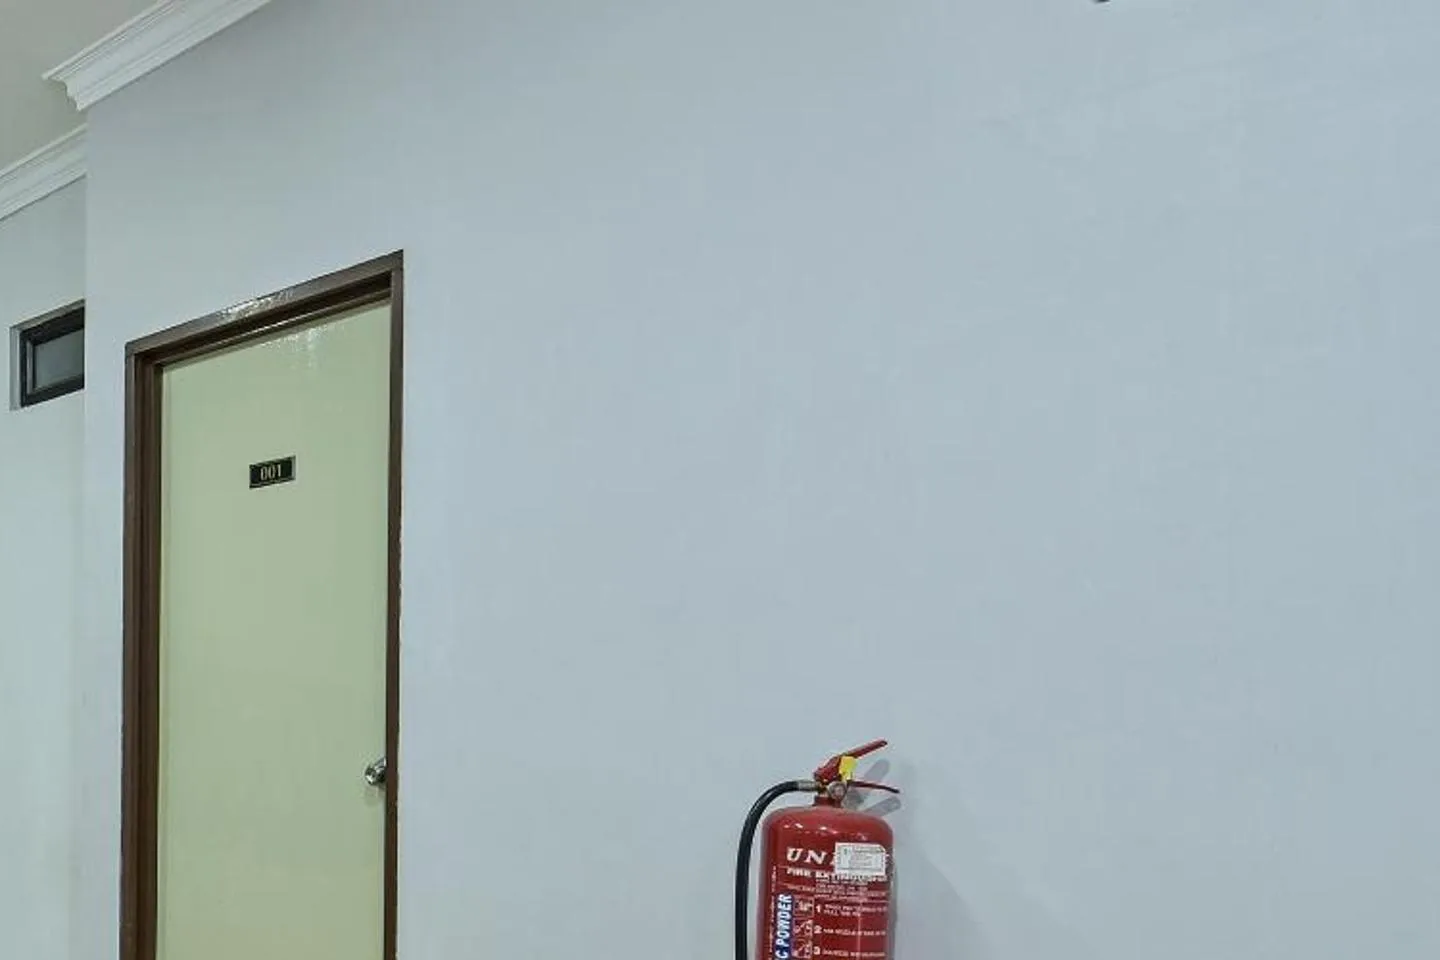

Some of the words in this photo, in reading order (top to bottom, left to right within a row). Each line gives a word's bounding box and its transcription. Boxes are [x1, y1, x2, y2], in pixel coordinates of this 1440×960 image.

[261, 464, 281, 480] 001
[776, 894, 792, 947] POWDER
[814, 925, 822, 934] 2
[814, 946, 821, 955] 3
